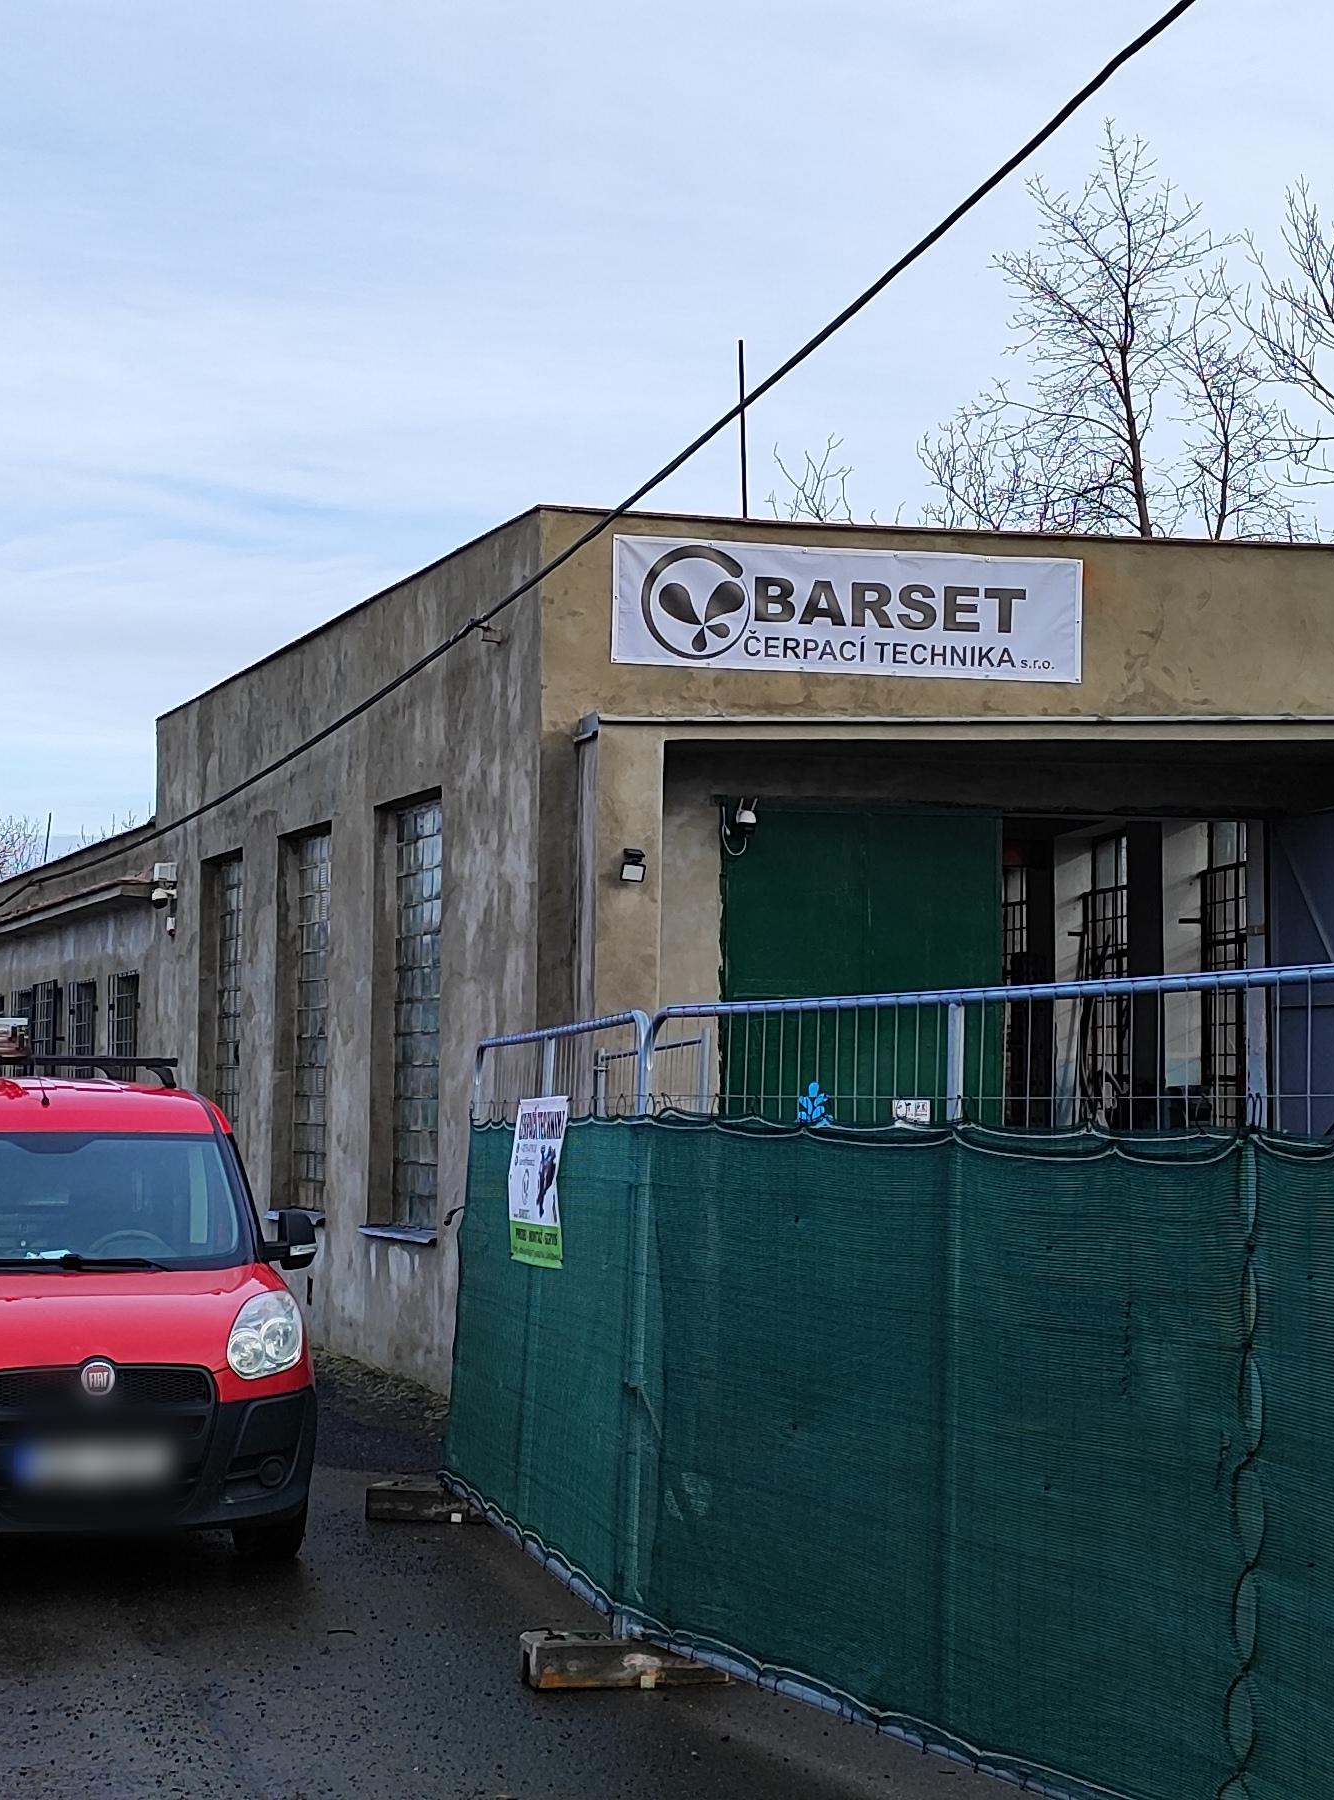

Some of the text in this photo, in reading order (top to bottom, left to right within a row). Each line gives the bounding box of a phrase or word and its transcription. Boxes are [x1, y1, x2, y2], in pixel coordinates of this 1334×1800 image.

[754, 576, 1027, 633] BARSET
[743, 629, 1055, 670] ČERPACÍ TECHNIKA s.r.o.
[89, 1371, 109, 1388] FIAT
